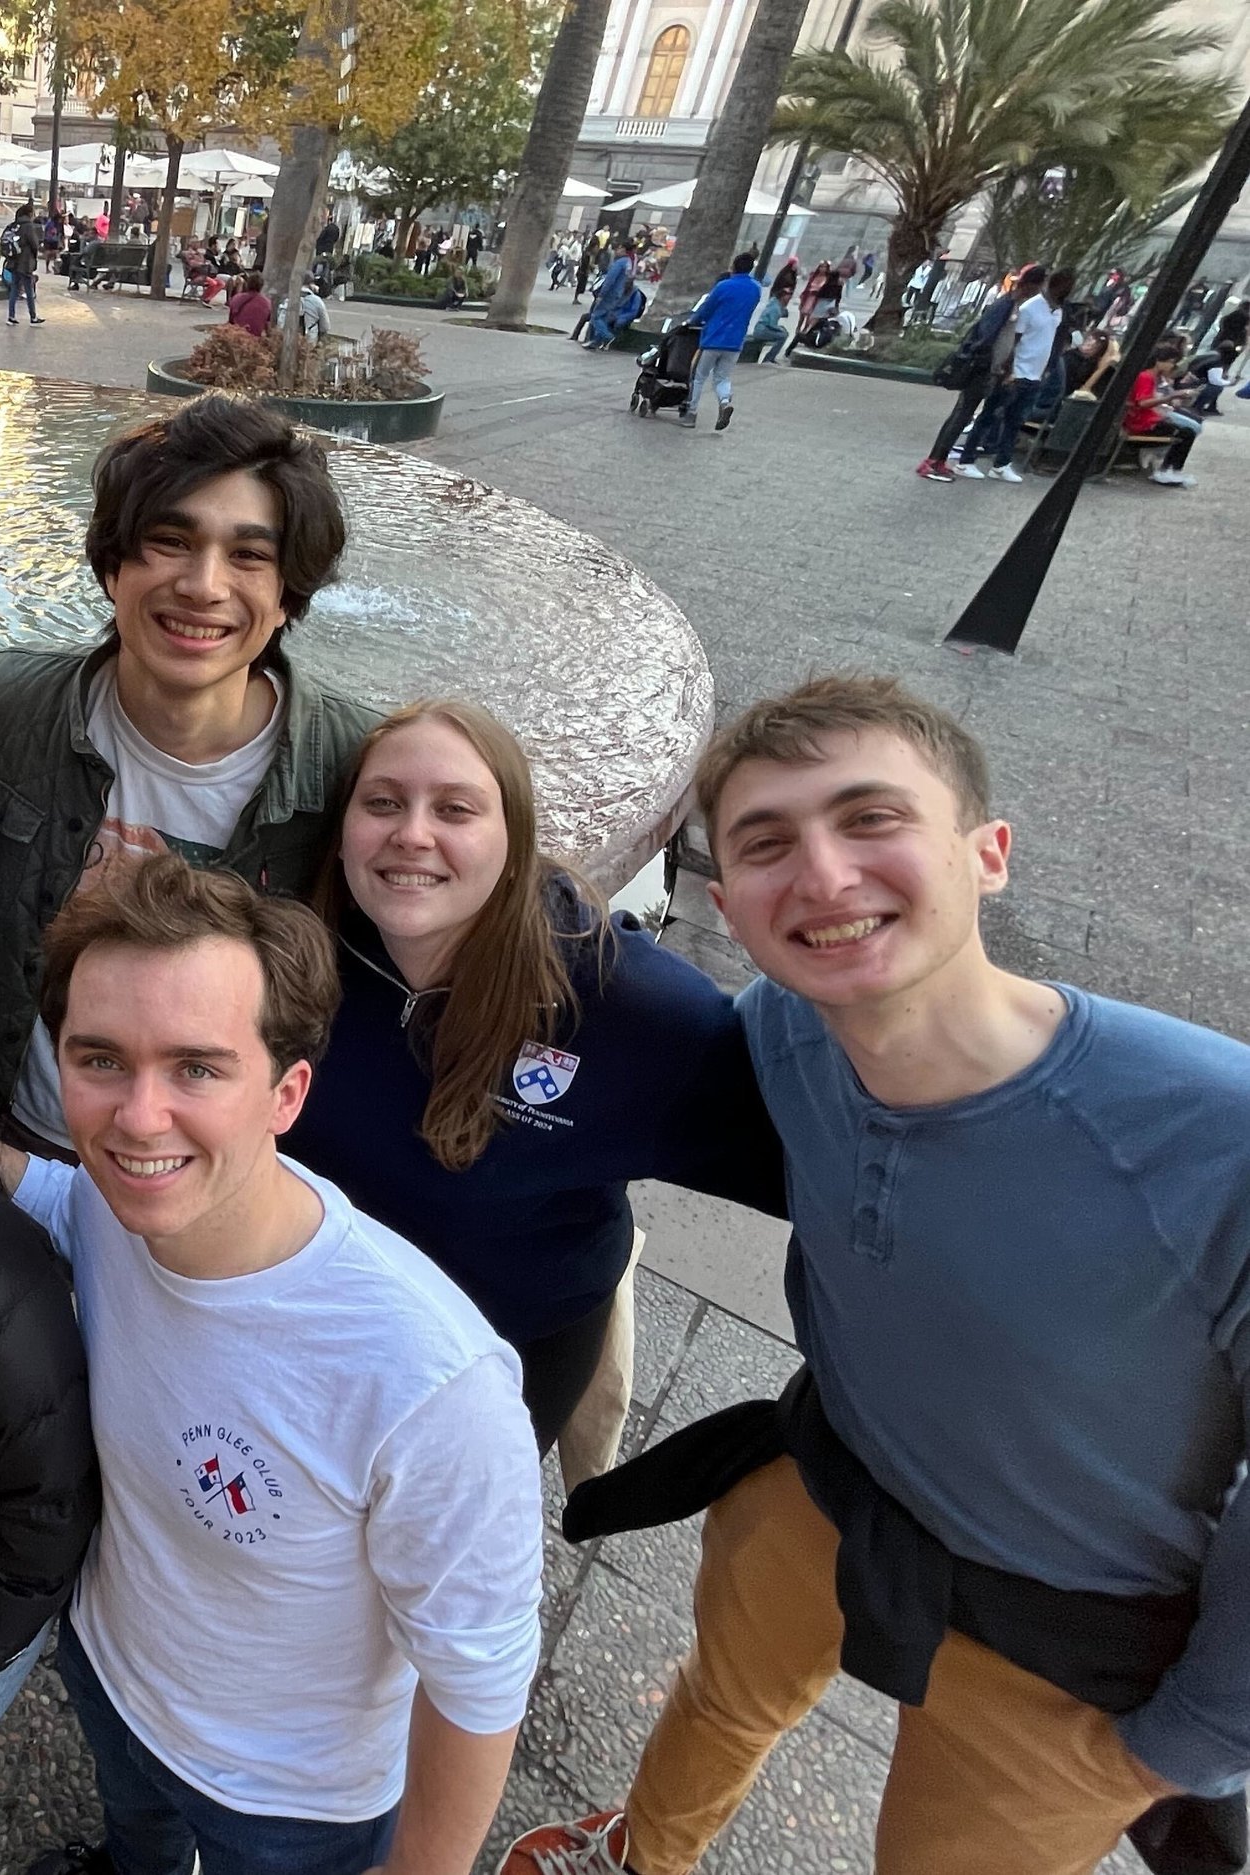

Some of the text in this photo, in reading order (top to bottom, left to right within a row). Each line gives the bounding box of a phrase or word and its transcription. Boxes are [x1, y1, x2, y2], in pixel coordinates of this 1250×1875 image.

[181, 1424, 283, 1498] PENN GLEE CLUB
[180, 1488, 267, 1544] TOUR 2023
